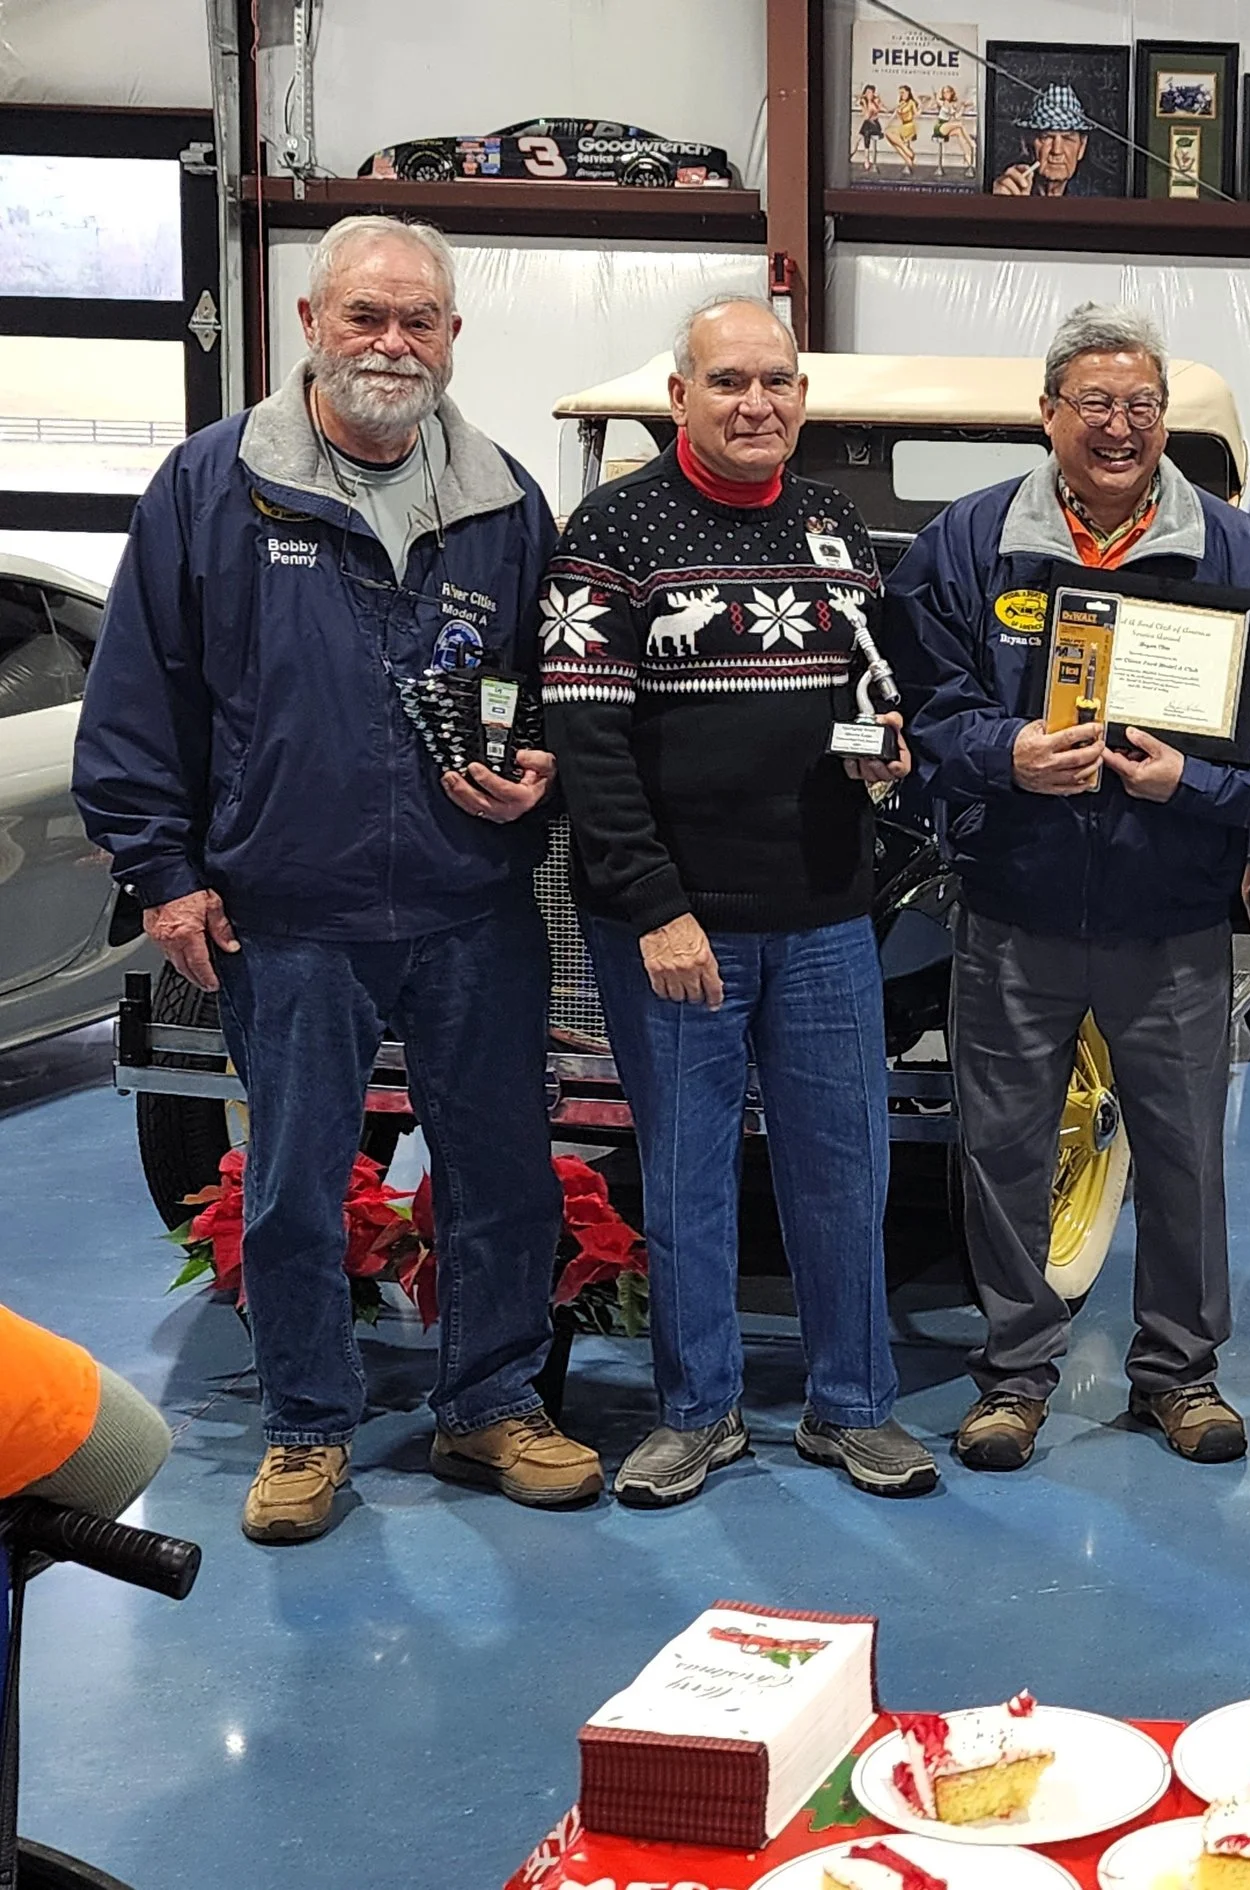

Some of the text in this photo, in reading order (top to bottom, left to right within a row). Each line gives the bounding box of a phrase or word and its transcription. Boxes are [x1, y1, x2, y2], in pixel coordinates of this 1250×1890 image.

[872, 48, 960, 68] PIEHOLE
[577, 136, 712, 156] Goodwrench
[517, 136, 568, 177] 3
[576, 153, 615, 164] Service
[267, 538, 318, 555] Bobby
[270, 551, 317, 568] Penny
[441, 582, 470, 602] River
[441, 603, 488, 626] Model A
[999, 633, 1028, 646] Bryan
